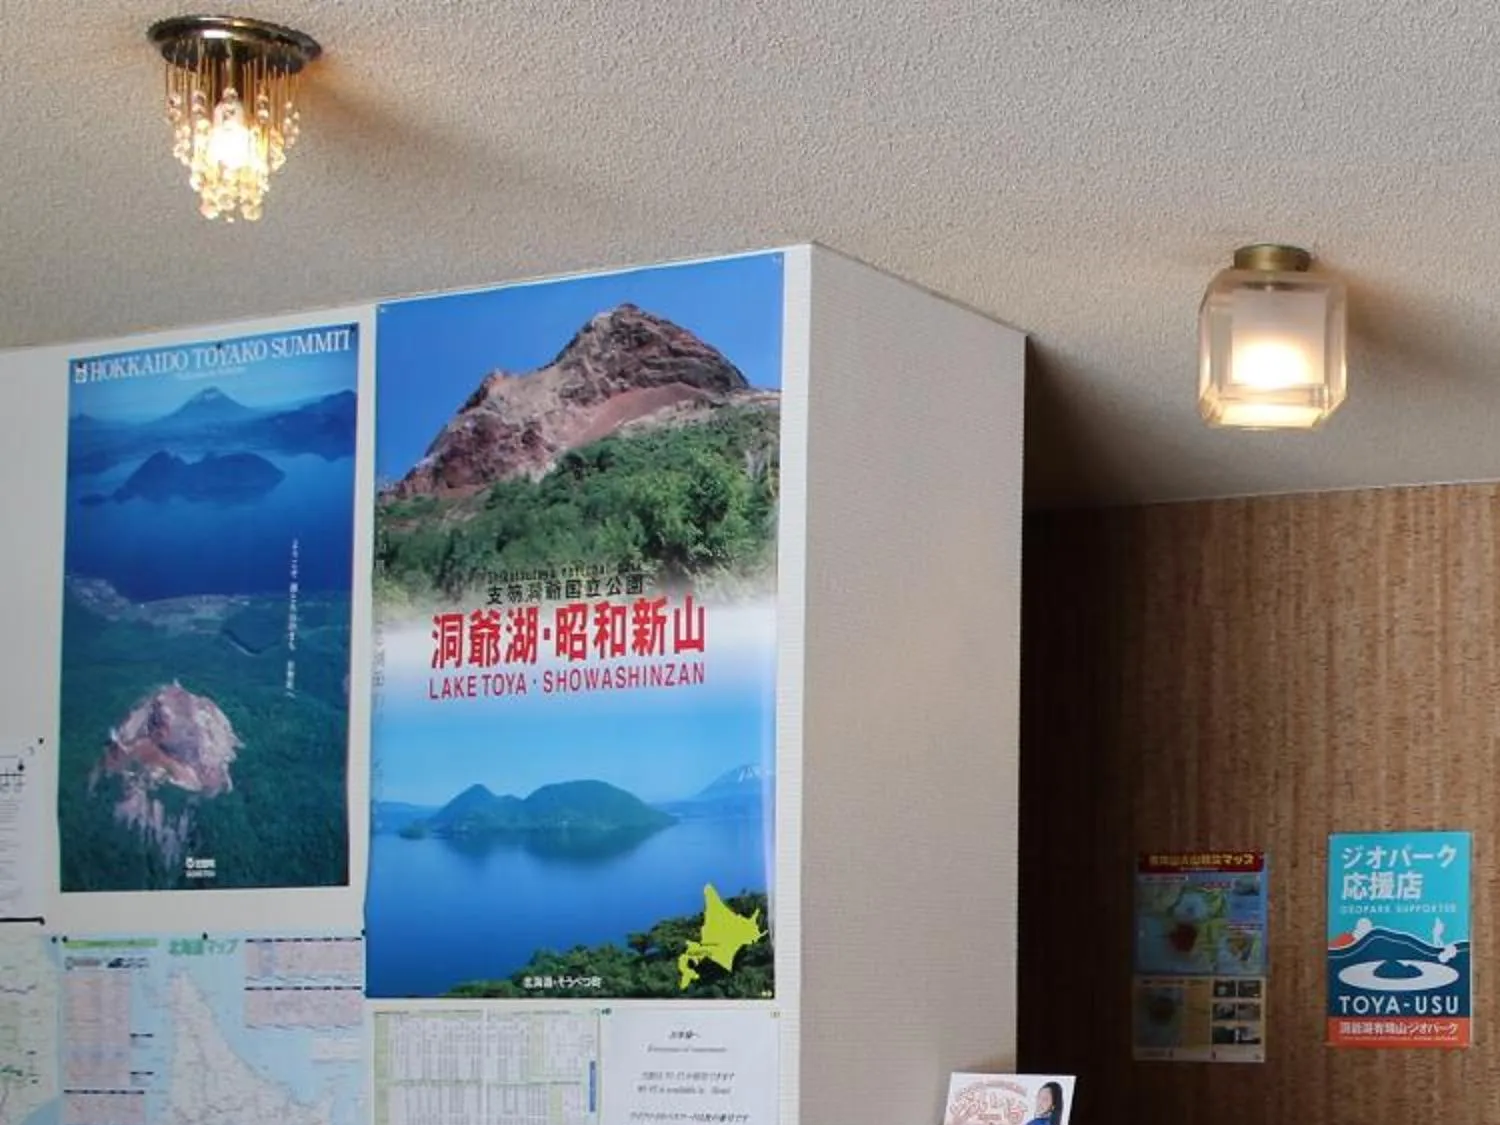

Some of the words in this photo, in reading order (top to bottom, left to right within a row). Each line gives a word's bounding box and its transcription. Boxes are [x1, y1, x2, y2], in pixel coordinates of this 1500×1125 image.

[90, 350, 188, 382] HOKKAIDO
[193, 338, 267, 369] TOYAKO
[271, 329, 350, 358] SUMMIT
[429, 675, 477, 699] LAKE
[481, 673, 527, 696] TOYA
[543, 663, 705, 693] SHOWASHINZAN
[1342, 845, 1457, 869] ジオパーク
[1342, 871, 1423, 900] 応援店
